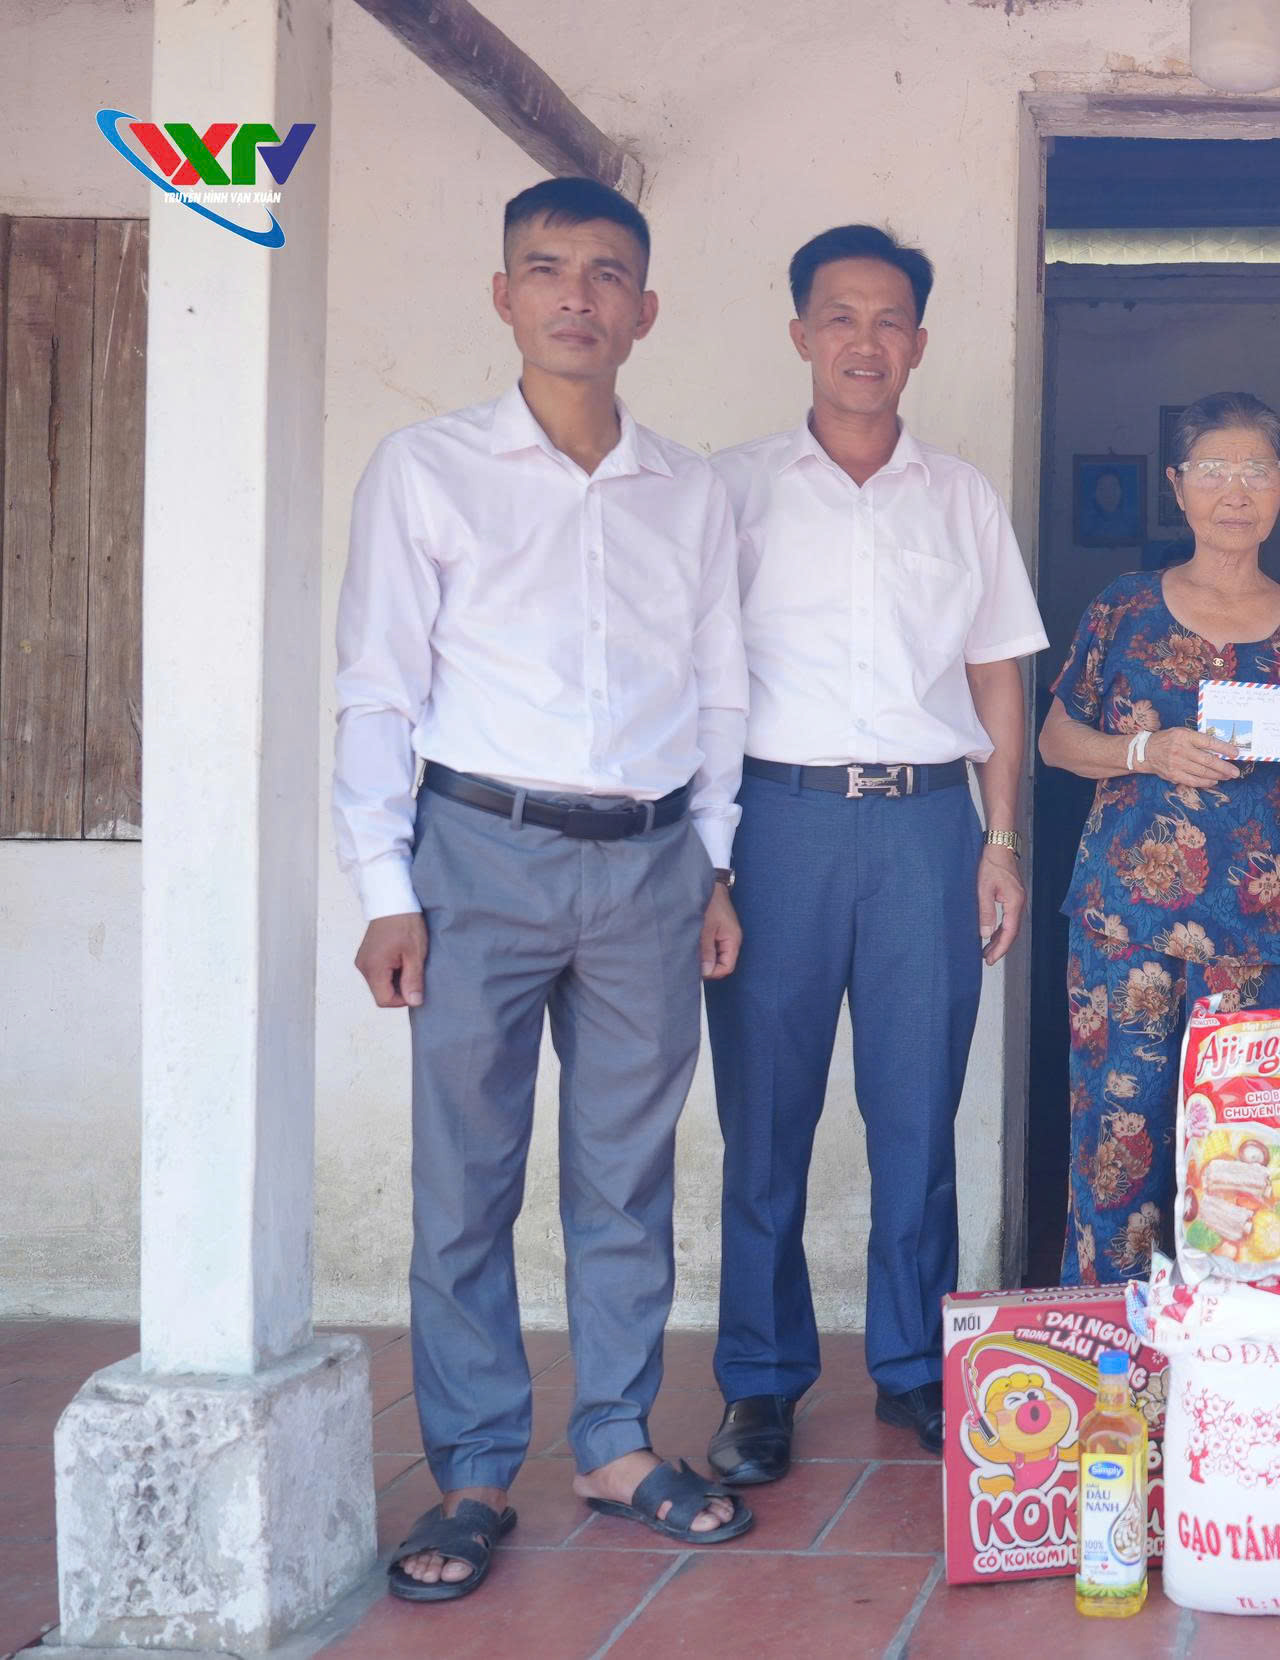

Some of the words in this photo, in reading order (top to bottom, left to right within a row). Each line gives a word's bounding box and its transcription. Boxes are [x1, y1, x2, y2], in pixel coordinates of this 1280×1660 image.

[1246, 1091, 1271, 1103] CHO
[1016, 1328, 1051, 1341] TRONG
[1085, 1318, 1142, 1355] NGON
[1091, 1464, 1121, 1477] Simply
[1178, 1511, 1222, 1561] GẠO
[1004, 1548, 1066, 1567] KOKOMI
